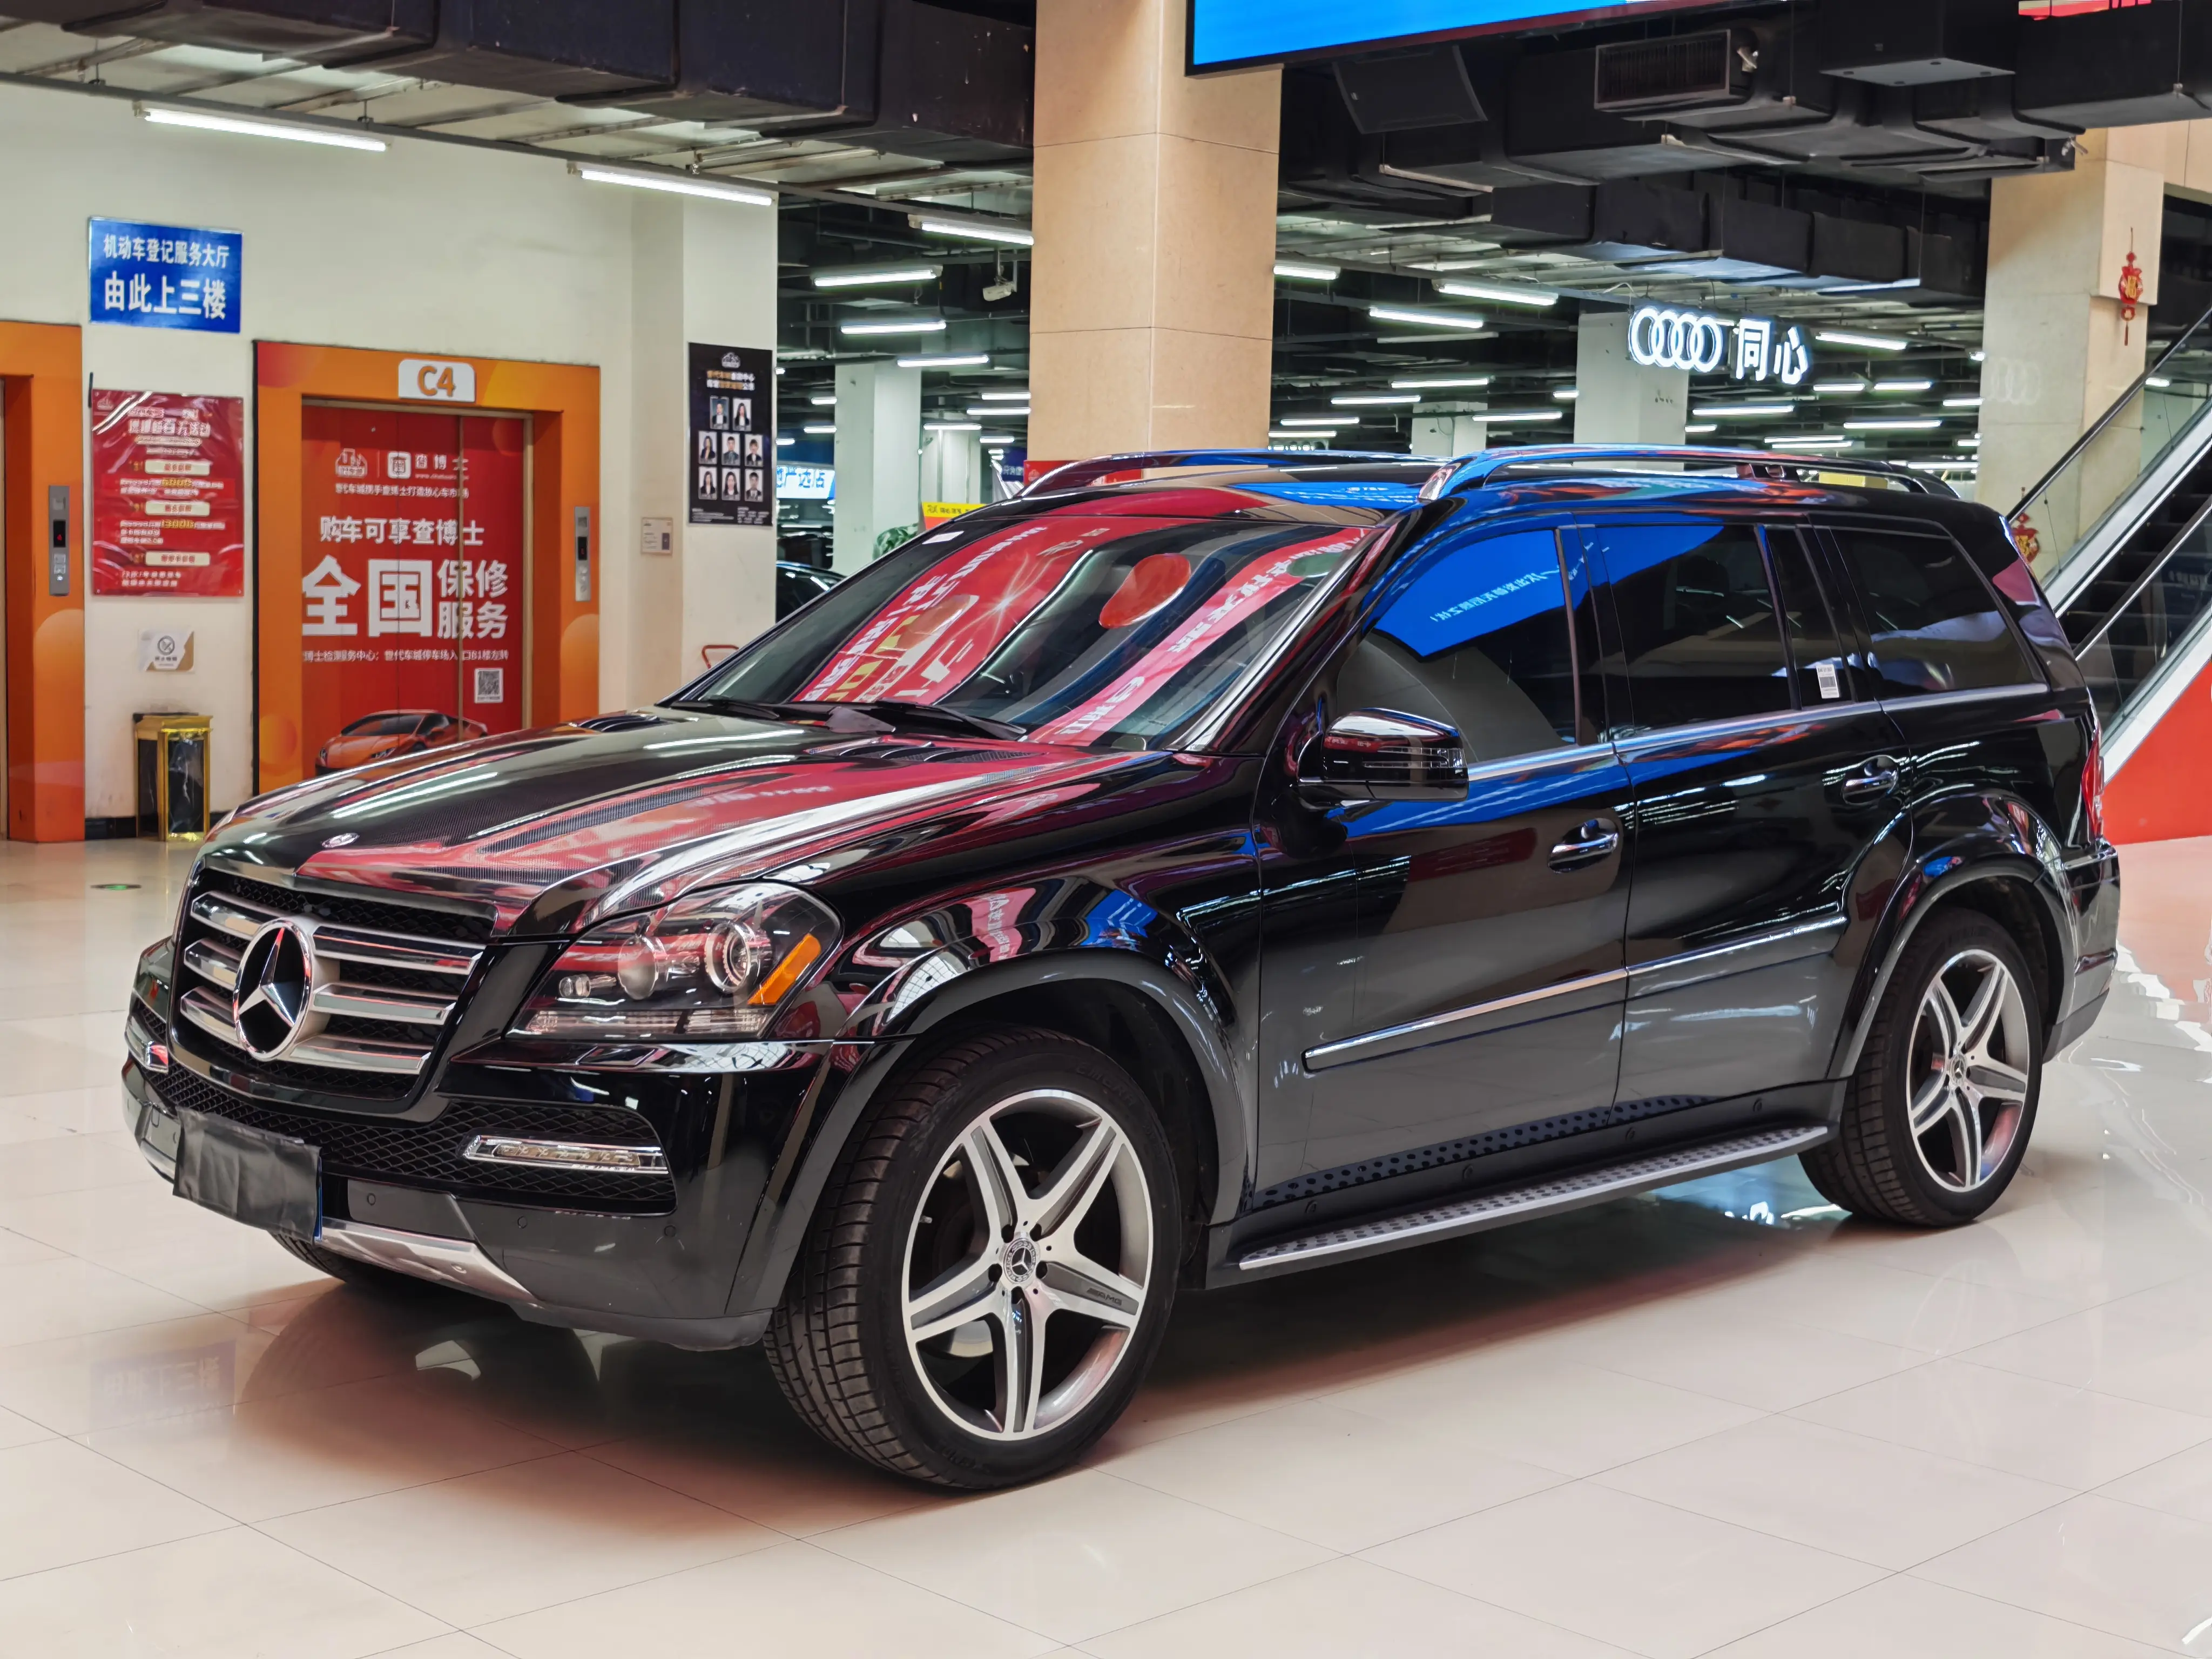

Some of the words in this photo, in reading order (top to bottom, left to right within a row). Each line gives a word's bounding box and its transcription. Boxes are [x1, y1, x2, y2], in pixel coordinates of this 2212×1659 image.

[104, 233, 230, 268] 机动车登记服务大厅
[104, 271, 226, 320] 由此上三楼
[1736, 318, 1809, 385] 同心
[417, 366, 456, 397] C4
[320, 515, 484, 545] 购车可享查博士
[302, 554, 433, 637] 全国
[437, 559, 508, 598] 保修
[437, 601, 508, 639] 服务
